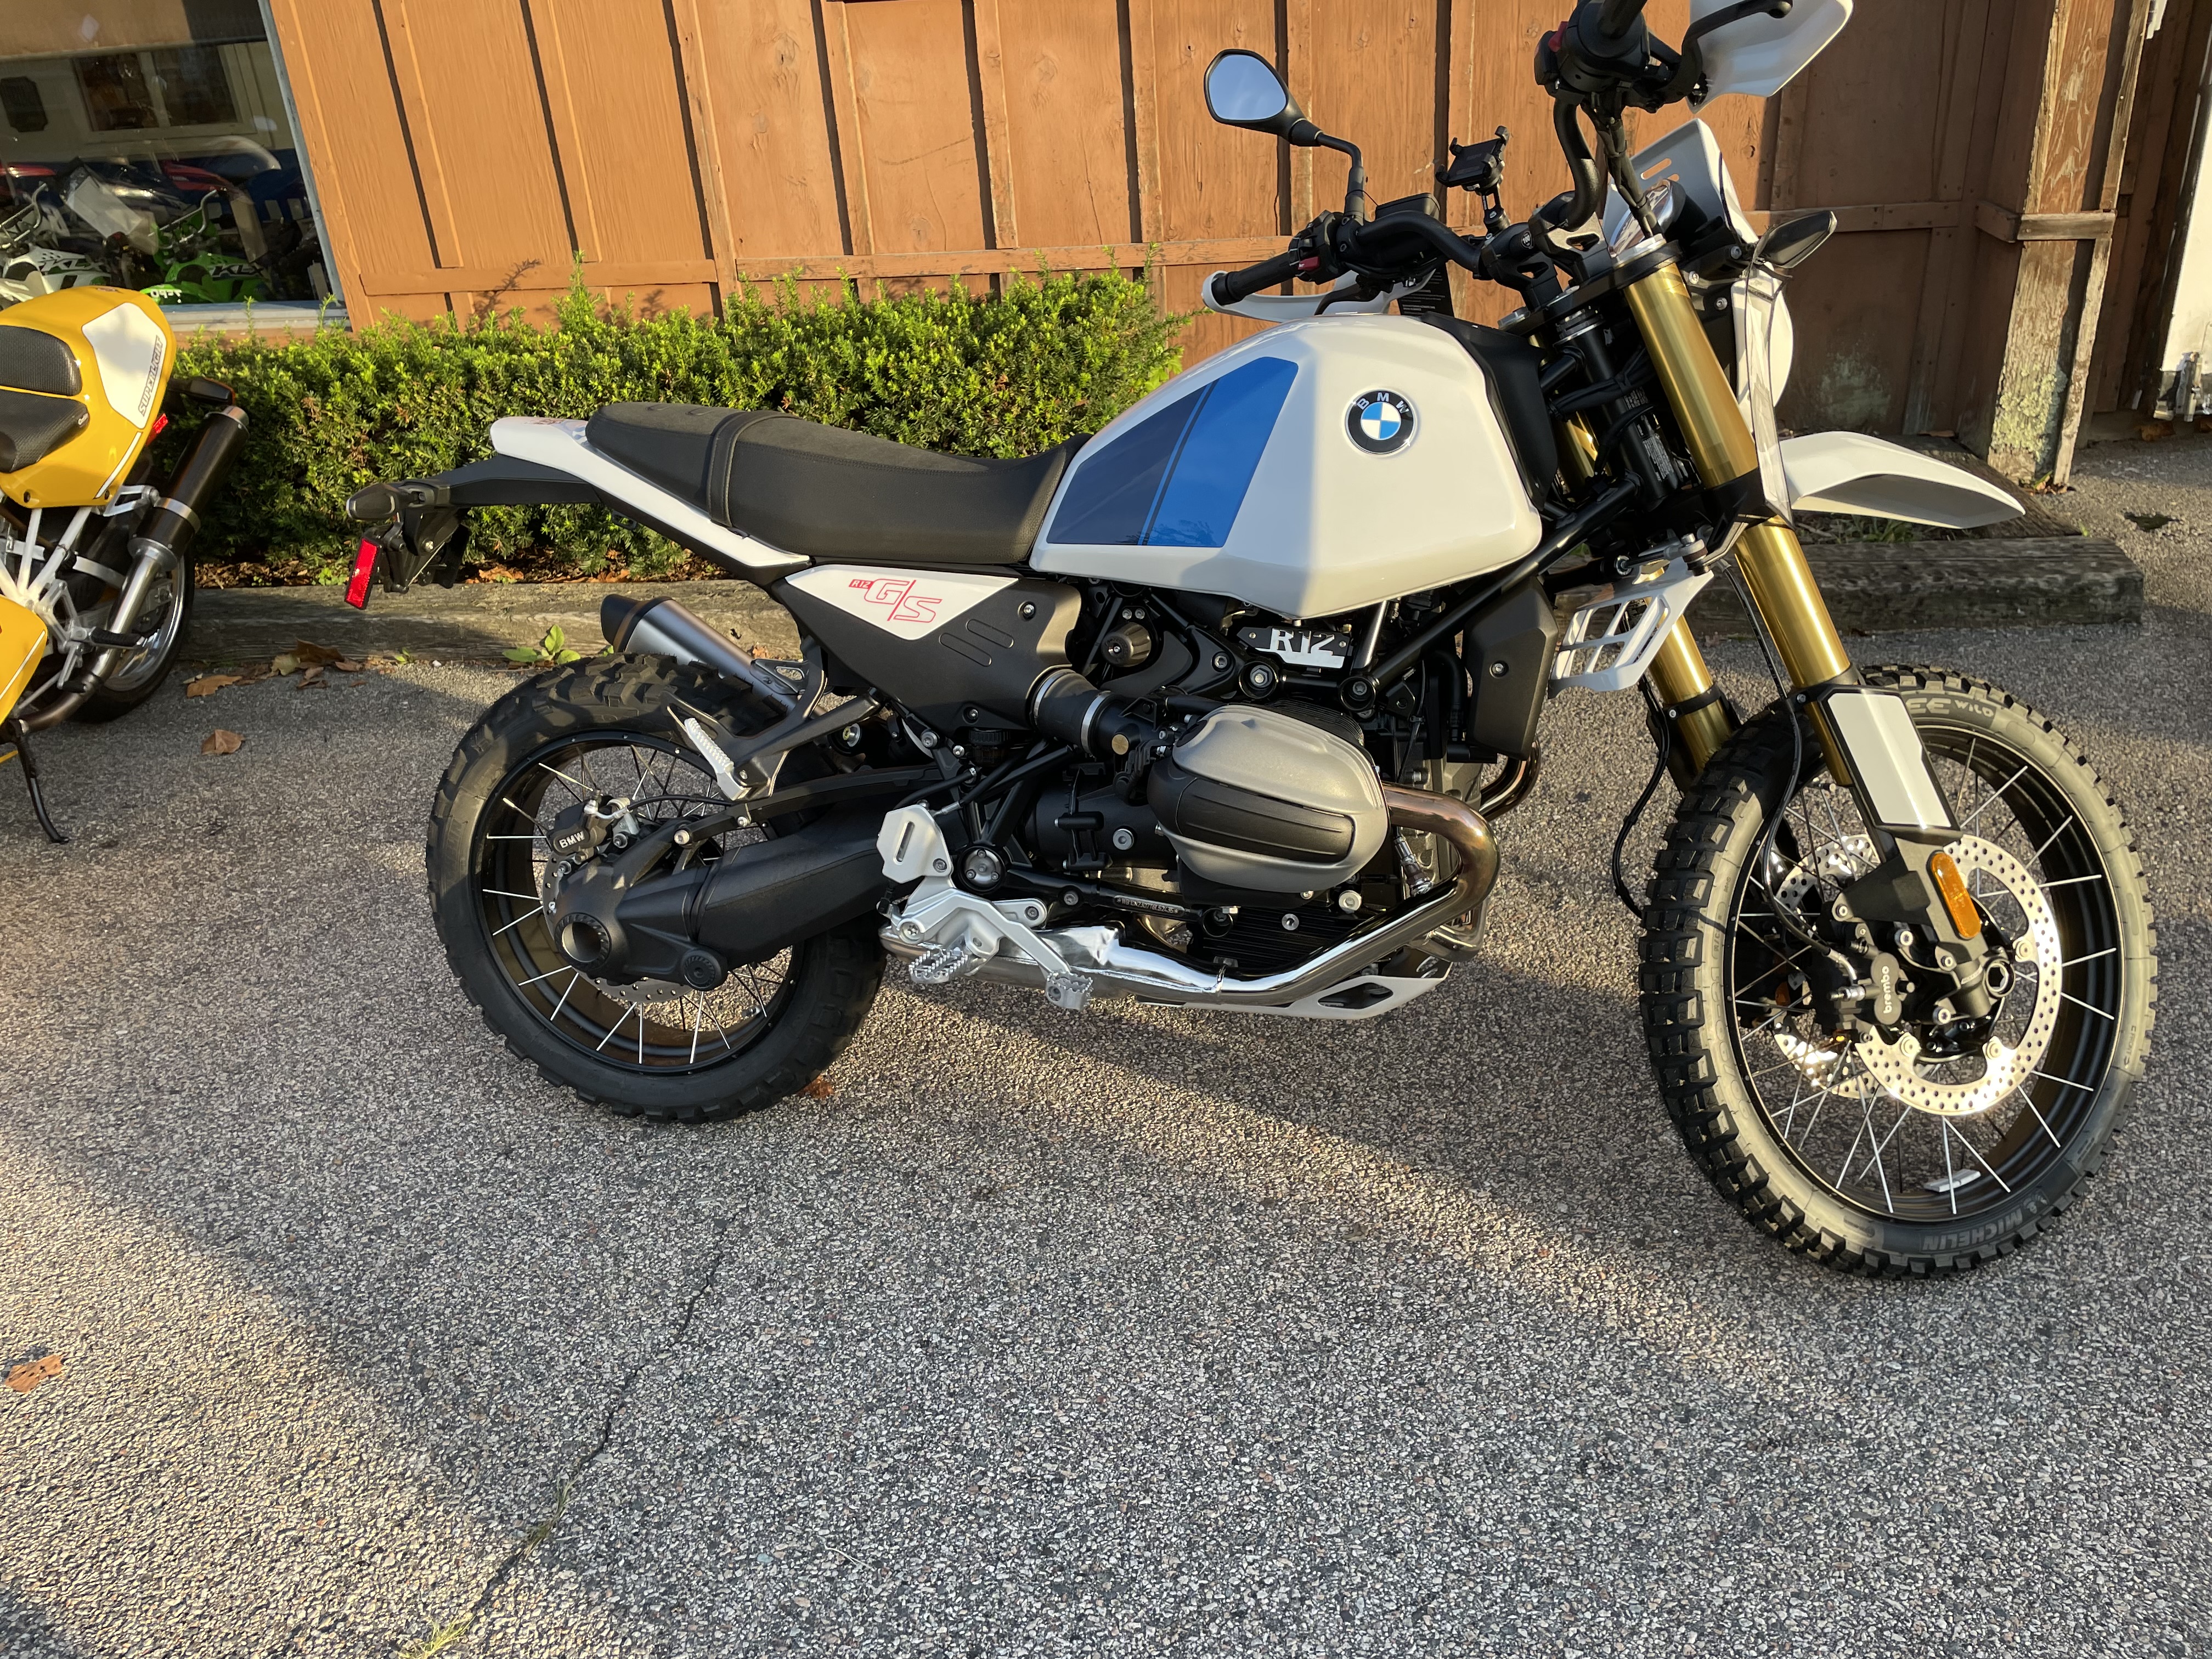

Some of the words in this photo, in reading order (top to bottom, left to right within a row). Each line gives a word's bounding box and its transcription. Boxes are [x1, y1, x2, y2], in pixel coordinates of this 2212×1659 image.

[39, 259, 110, 273] KLX
[212, 265, 264, 276] KLX
[138, 335, 163, 417] SUPERLIGHT
[1356, 392, 1409, 414] BMW
[851, 580, 871, 589] R12
[1270, 628, 1335, 656] R12
[559, 831, 585, 848] BMW
[1881, 966, 1892, 1013] brembo
[1922, 1208, 2023, 1250] MICHELIN
